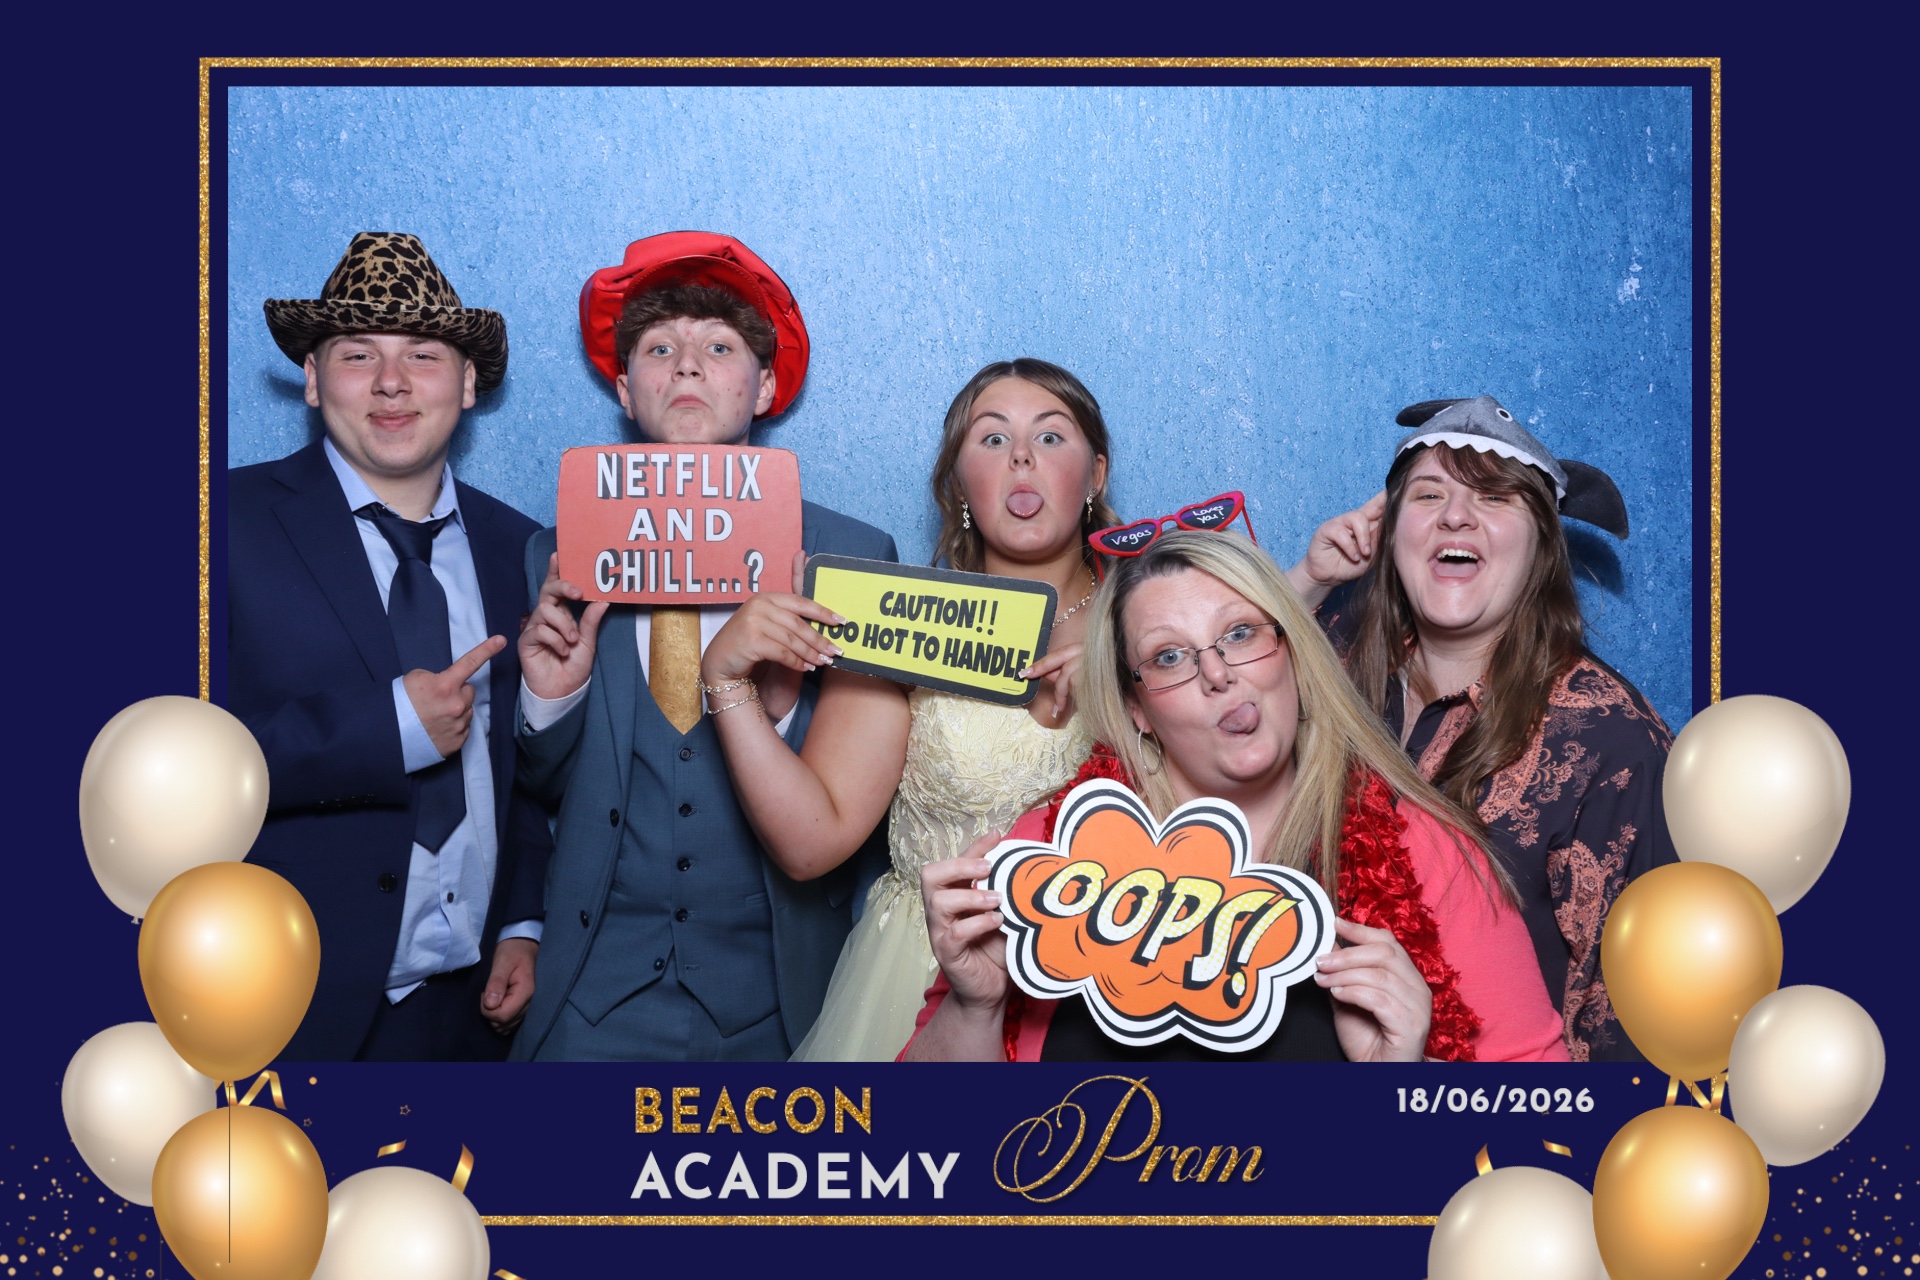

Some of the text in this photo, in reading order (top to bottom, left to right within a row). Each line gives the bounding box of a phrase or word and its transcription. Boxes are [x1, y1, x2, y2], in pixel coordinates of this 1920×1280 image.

[596, 452, 763, 501] NETFLIX
[626, 507, 734, 542] AND
[1111, 529, 1153, 546] Vegas
[594, 548, 765, 594] CHILL...?
[879, 590, 999, 636] CAUTION!!
[862, 623, 908, 655] HOT
[912, 630, 940, 661] TO
[942, 637, 1031, 683] HANDLE
[1031, 860, 1304, 1009] OOPS!
